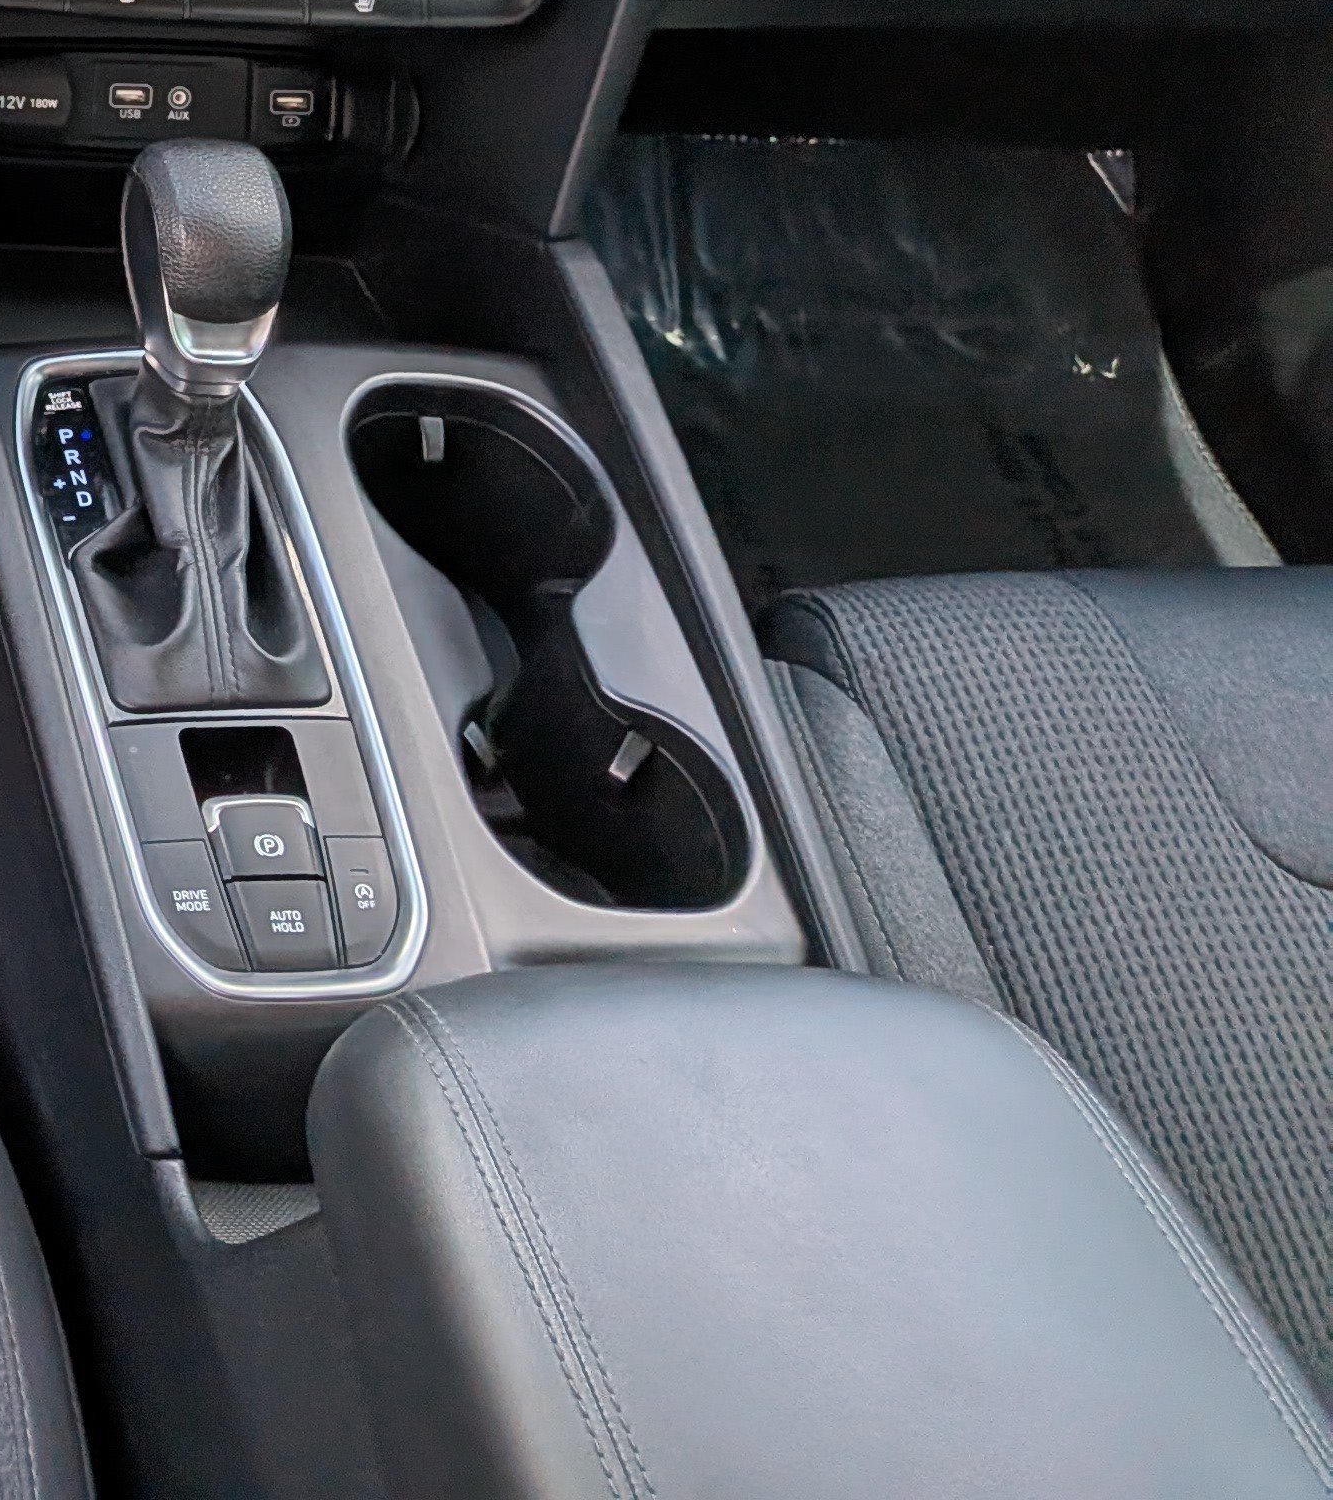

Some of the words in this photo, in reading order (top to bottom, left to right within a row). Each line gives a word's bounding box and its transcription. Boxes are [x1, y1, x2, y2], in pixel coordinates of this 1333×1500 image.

[30, 98, 58, 109] 180W
[119, 109, 141, 120] USB
[167, 110, 190, 121] AUX
[45, 401, 83, 411] RELEASE
[58, 428, 74, 445] P
[63, 449, 82, 466] R
[69, 469, 88, 486] N
[75, 490, 93, 507] D
[172, 889, 209, 901] DRIVE
[175, 900, 211, 912] MODE
[357, 900, 376, 909] OFF
[269, 910, 302, 921] AUTO
[272, 921, 305, 933] HOLD
